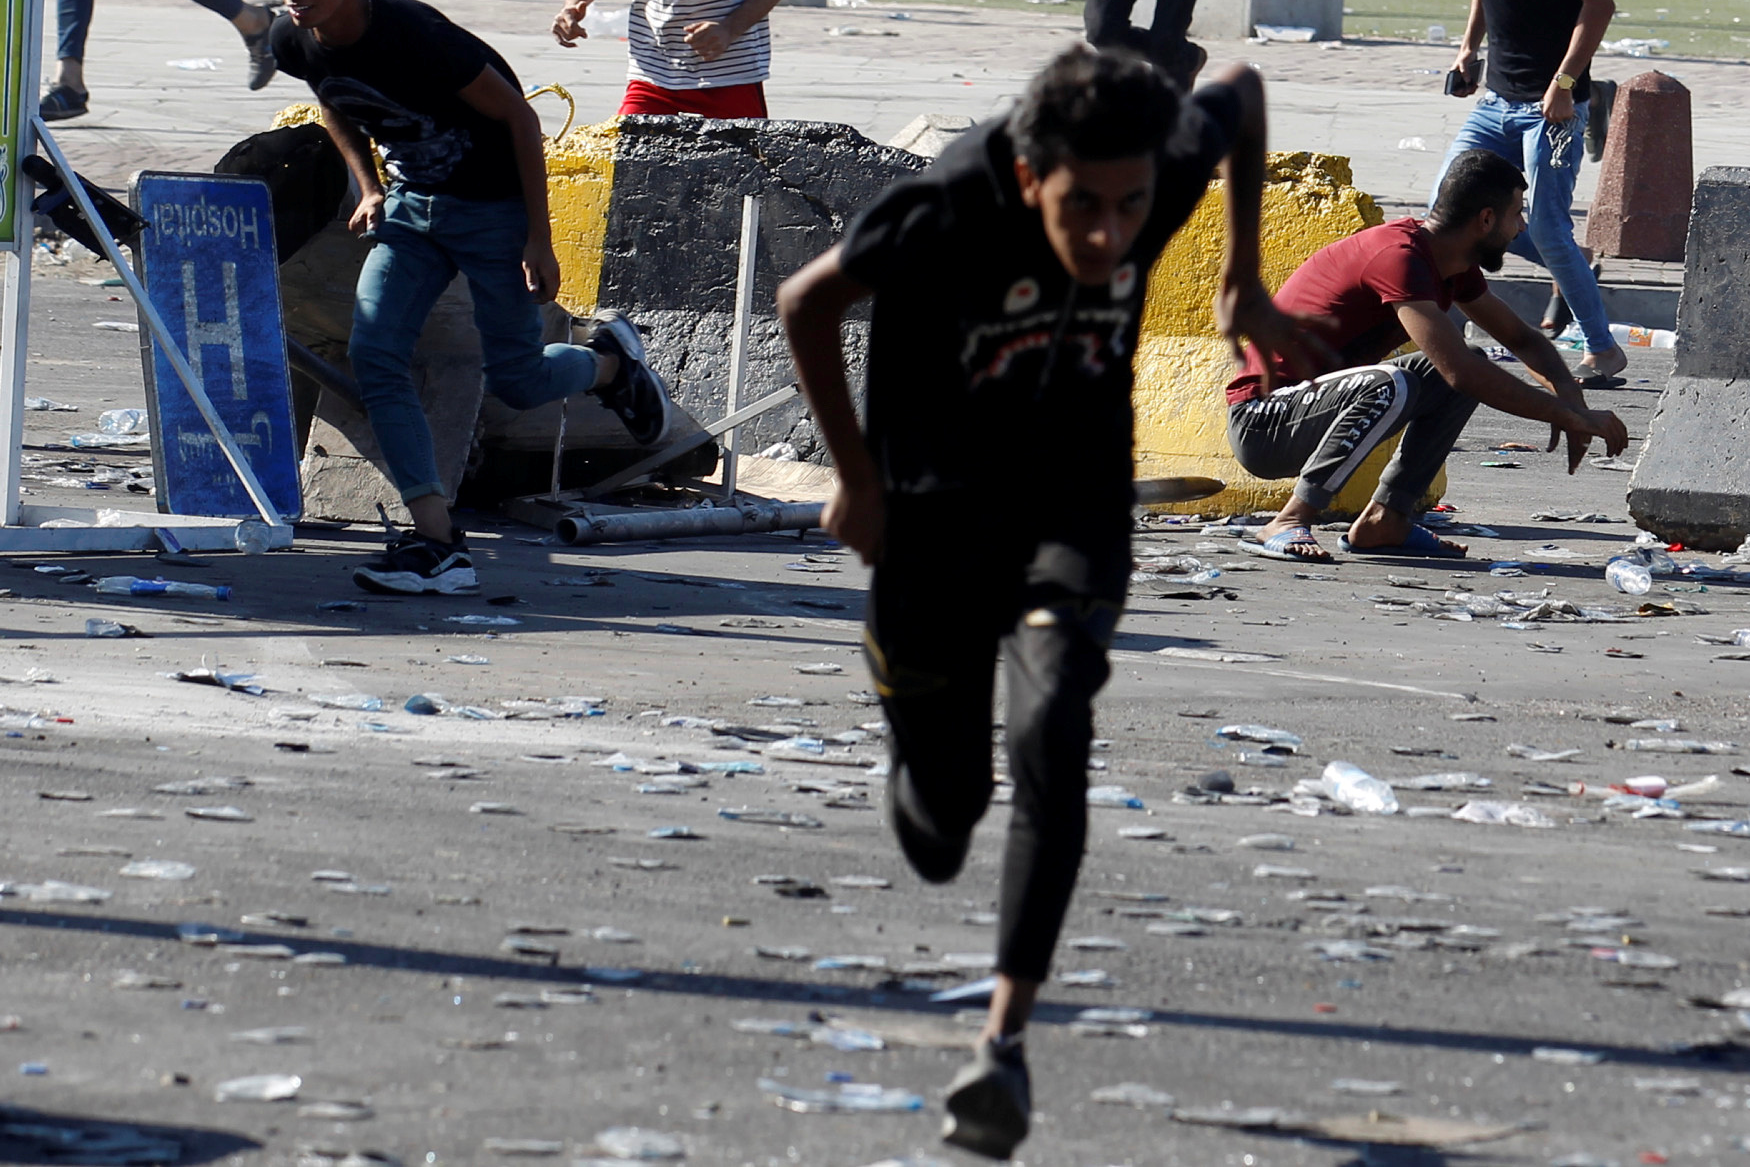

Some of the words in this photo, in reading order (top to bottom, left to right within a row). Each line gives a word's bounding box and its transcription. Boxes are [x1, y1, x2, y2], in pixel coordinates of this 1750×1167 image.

[153, 195, 261, 249] Hospital
[181, 261, 248, 400] H
[1302, 383, 1328, 405] of
